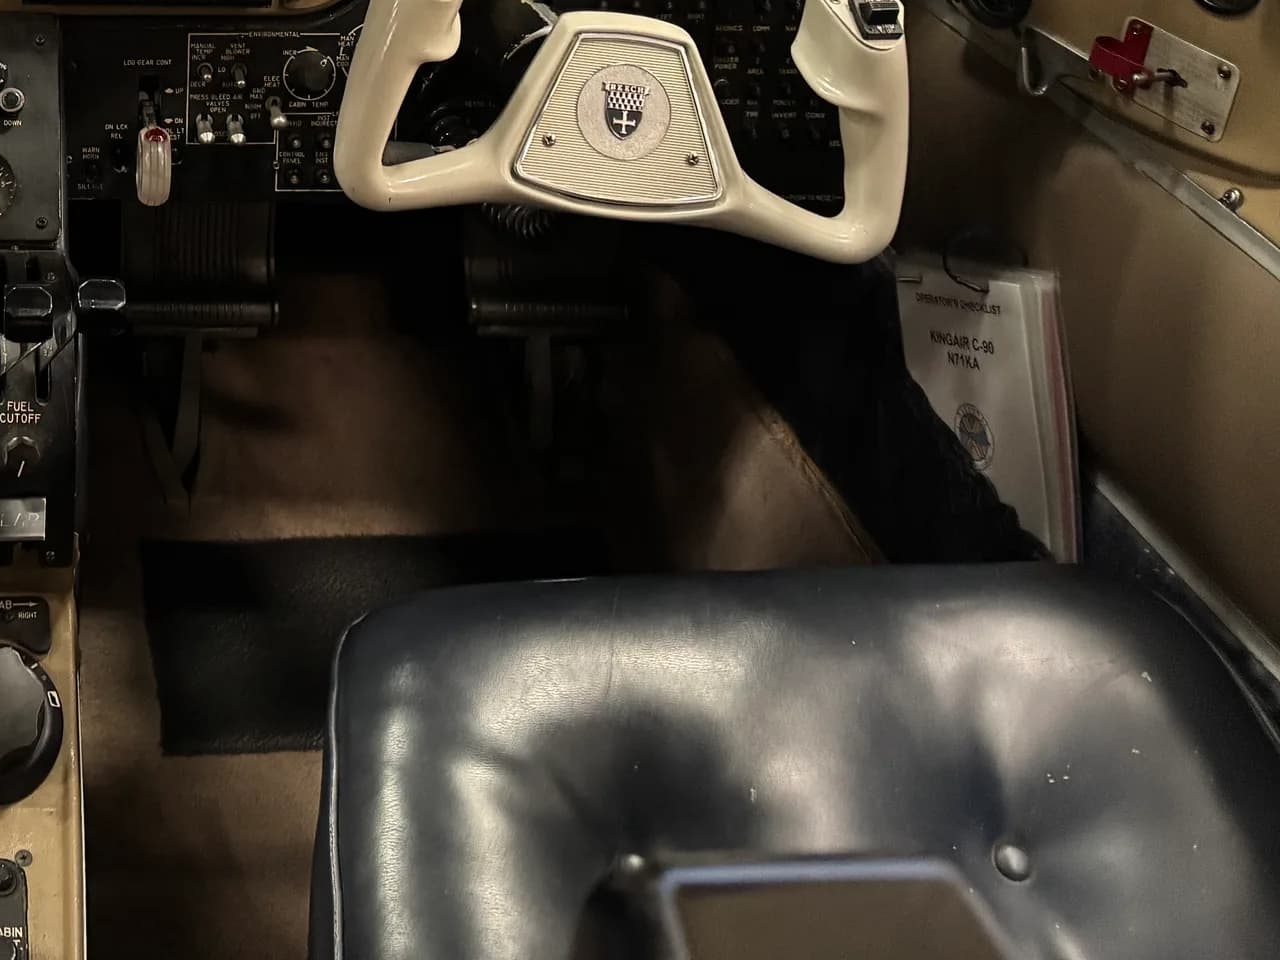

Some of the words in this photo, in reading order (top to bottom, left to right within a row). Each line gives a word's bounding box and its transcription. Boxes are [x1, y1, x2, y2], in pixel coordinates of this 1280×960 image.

[175, 87, 184, 95] UP
[609, 83, 647, 97] BEECH
[3, 119, 22, 127] DOWN
[930, 331, 969, 349] KINGAIR
[972, 338, 994, 354] C-90
[947, 351, 980, 370] N71KA
[7, 400, 34, 412] FUEL
[0, 412, 42, 424] CUTOFF
[18, 611, 38, 620] RIGHT
